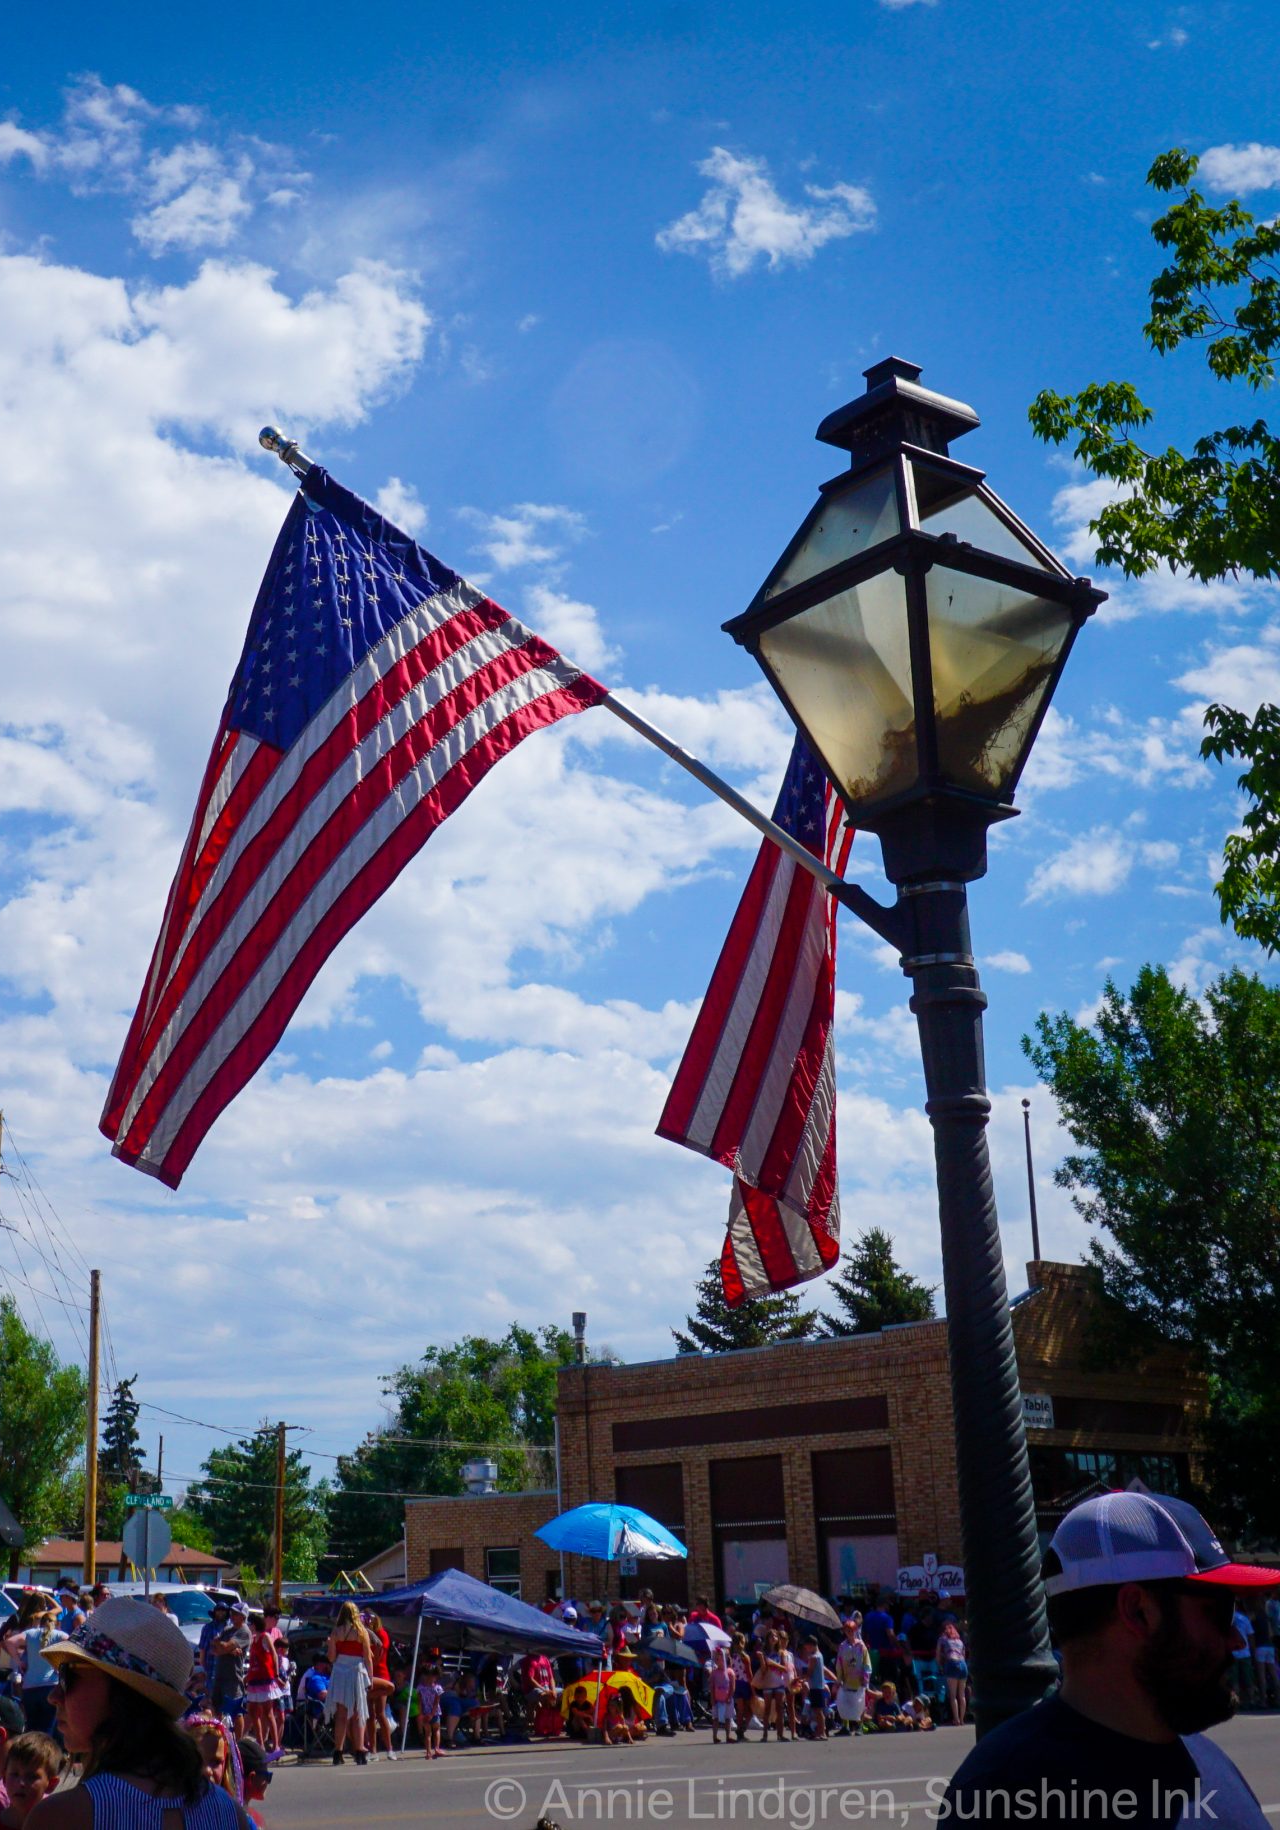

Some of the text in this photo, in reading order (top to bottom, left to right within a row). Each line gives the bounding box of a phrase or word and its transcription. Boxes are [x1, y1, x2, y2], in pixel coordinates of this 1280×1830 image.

[1024, 1398, 1050, 1412] Table
[126, 1495, 165, 1506] CLEVELAND
[899, 1571, 962, 1590] Papa's Table
